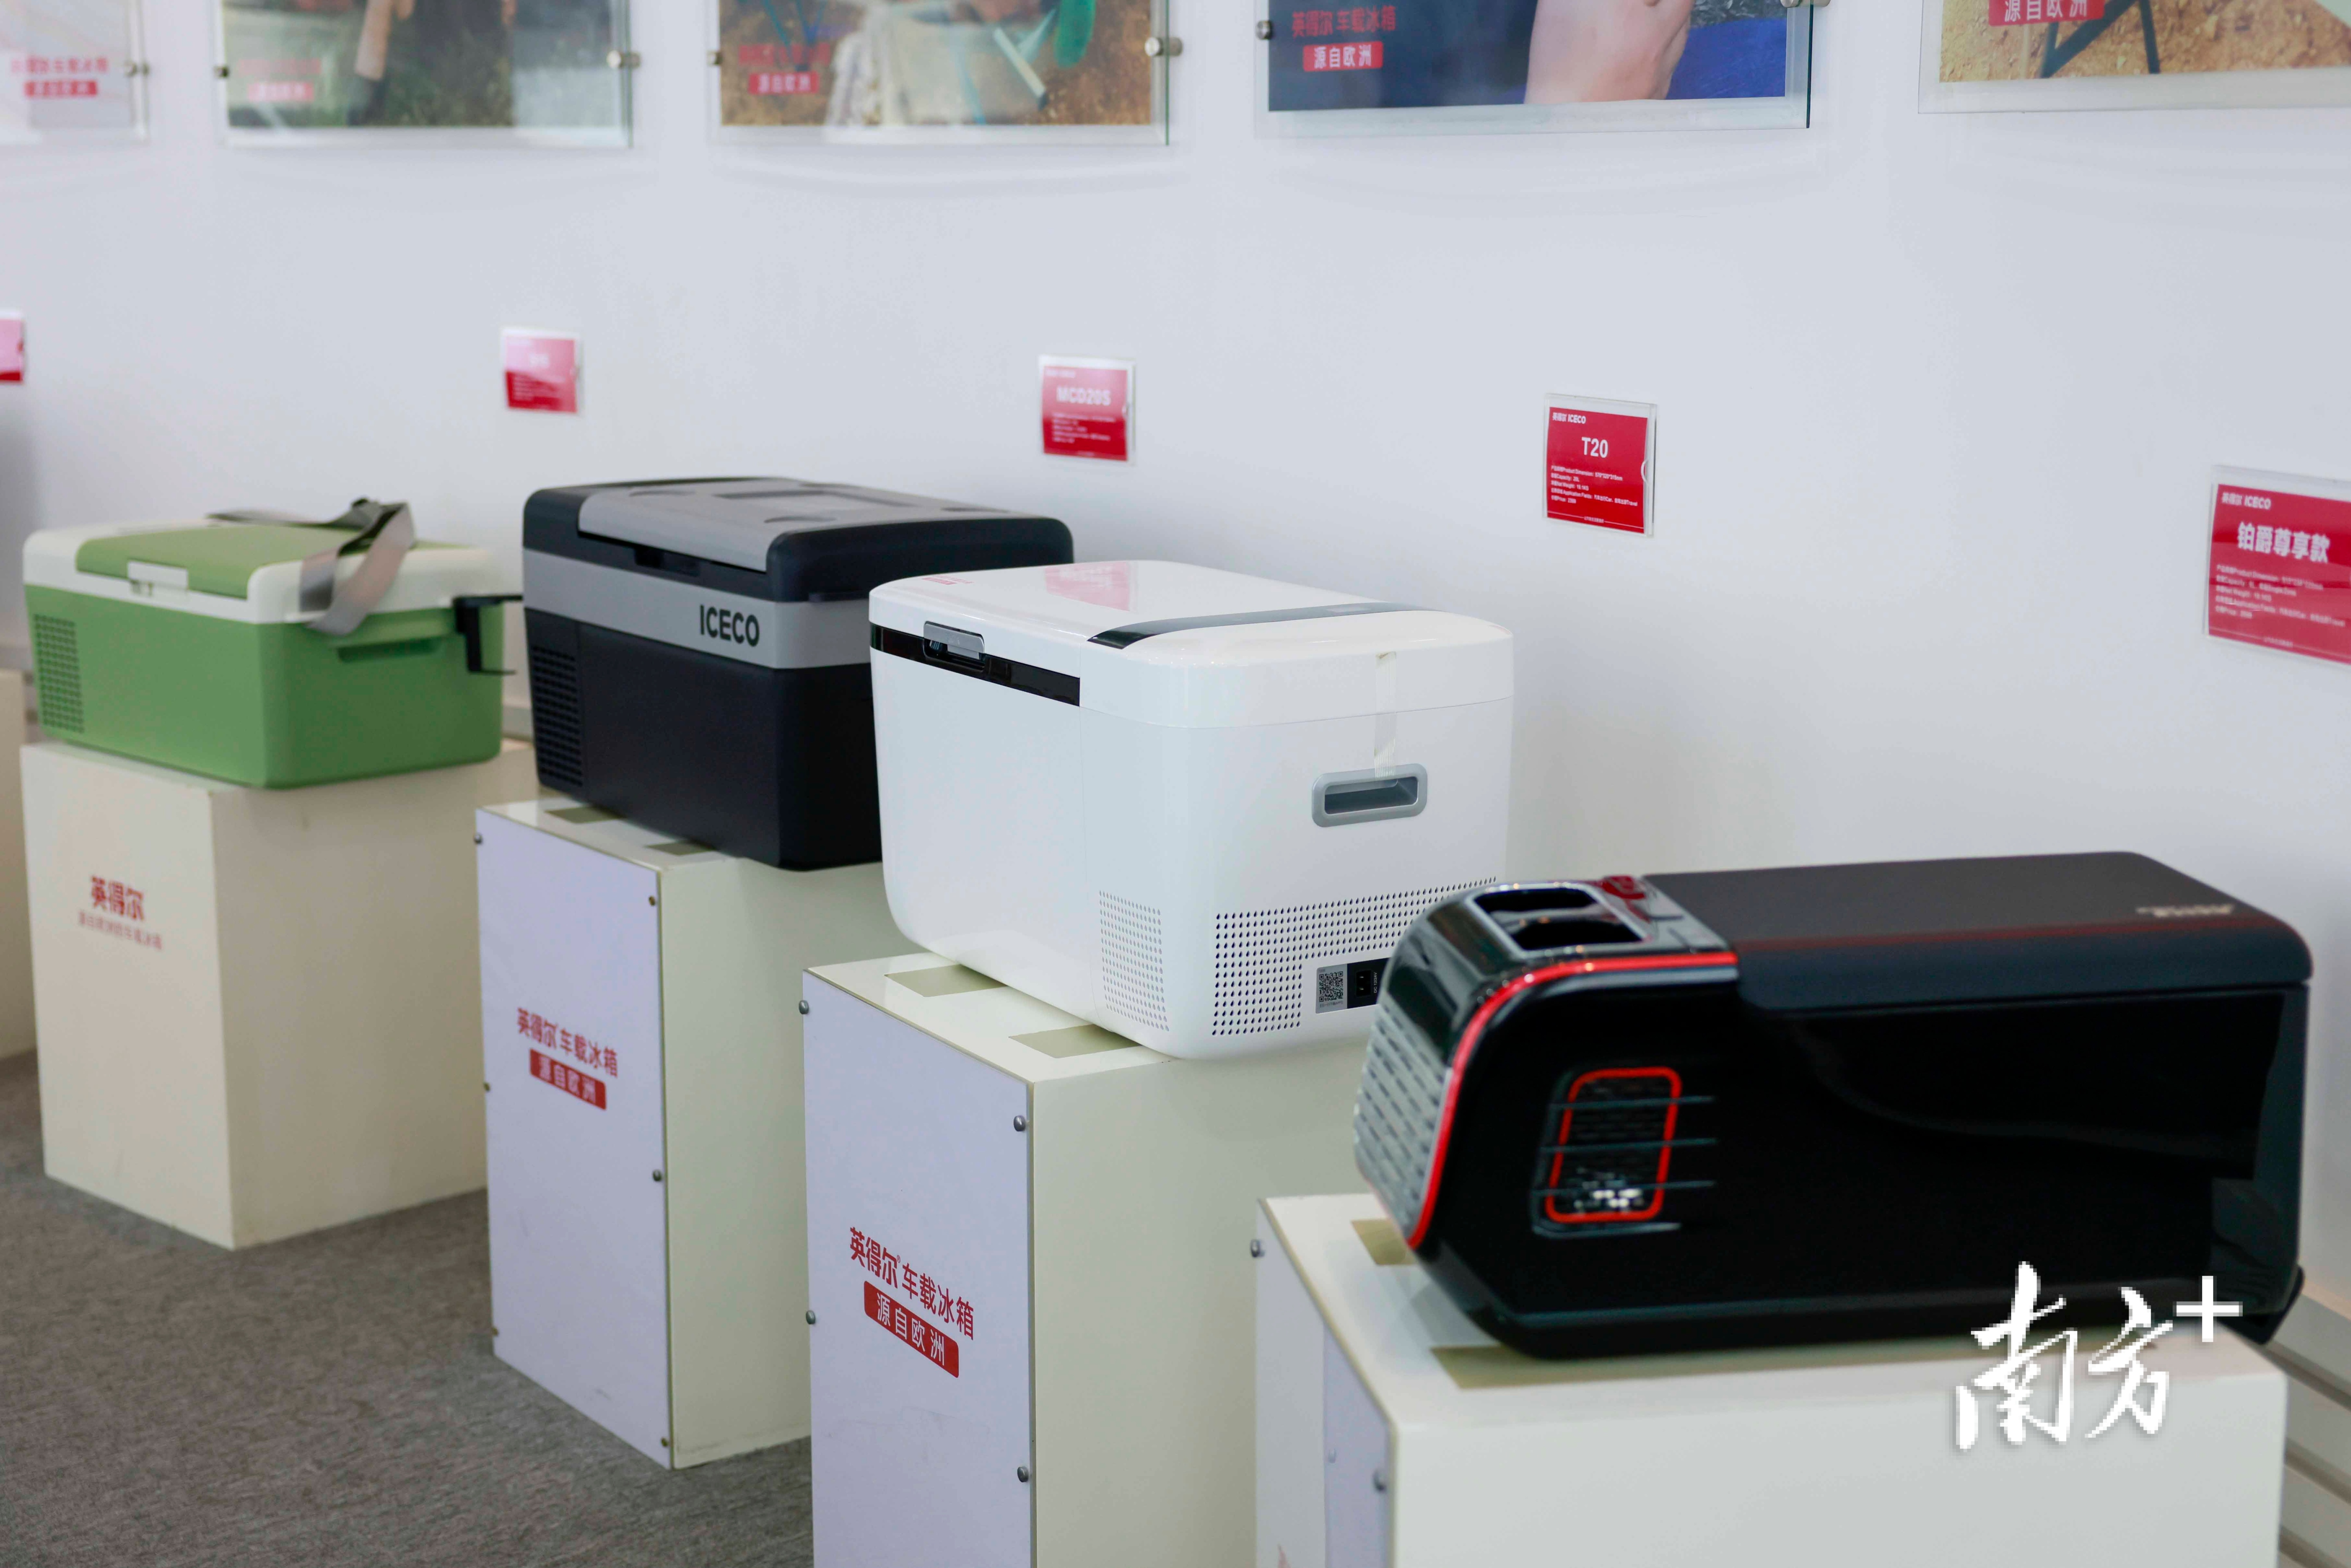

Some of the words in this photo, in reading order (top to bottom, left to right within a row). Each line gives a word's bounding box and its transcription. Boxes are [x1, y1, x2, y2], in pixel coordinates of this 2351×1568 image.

[2004, 0, 2087, 22] 源自欧洲
[1314, 45, 1372, 68] 源自欧洲
[1567, 414, 1586, 424] ICECO
[1581, 437, 1608, 458] T20
[2244, 495, 2271, 509] ICECO
[2237, 521, 2330, 564] 铂爵尊享款
[700, 604, 760, 647] ICECO
[877, 1292, 945, 1366] 源自欧洲
